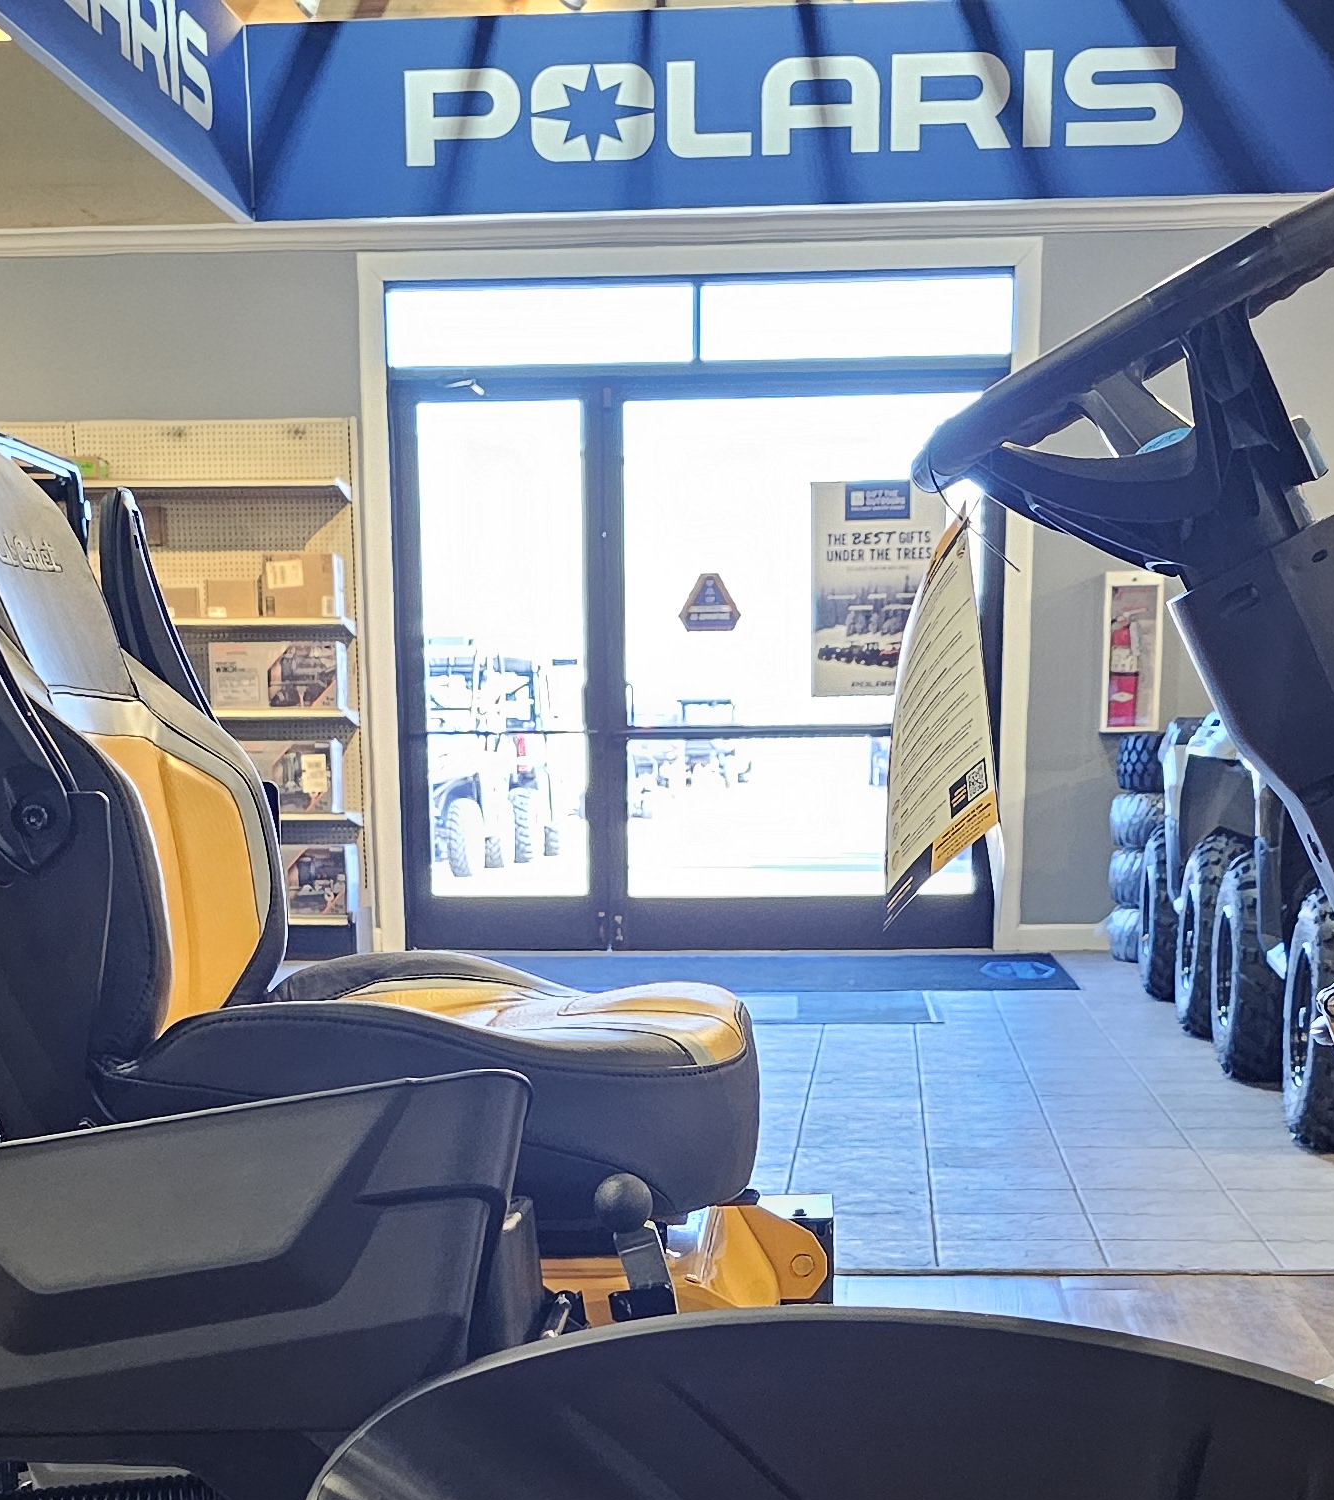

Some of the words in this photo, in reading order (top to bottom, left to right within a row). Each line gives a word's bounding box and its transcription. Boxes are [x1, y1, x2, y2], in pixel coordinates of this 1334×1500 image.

[404, 46, 1184, 166] POLARIS
[827, 533, 847, 546] THE
[851, 531, 897, 545] BEST
[898, 531, 932, 545] GIFTS
[826, 549, 865, 562] UNDER
[869, 548, 892, 561] THE
[896, 547, 932, 560] TREES
